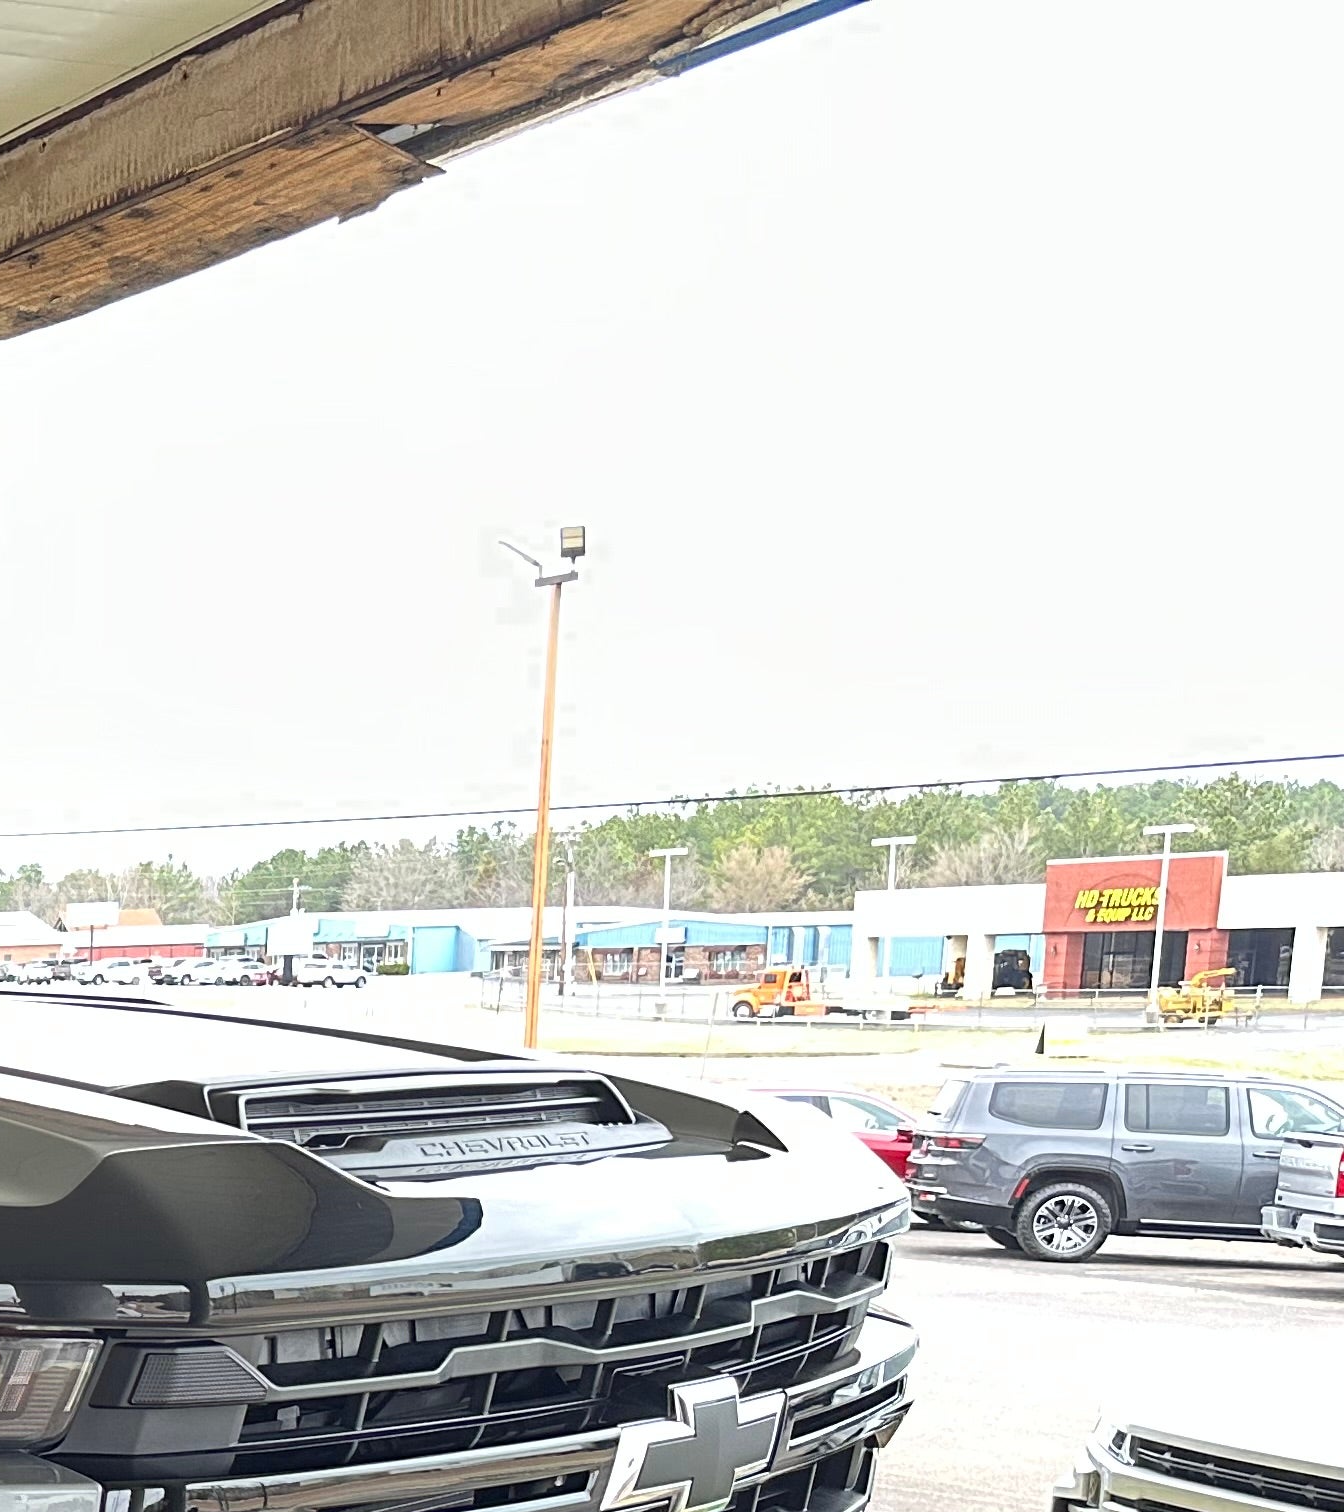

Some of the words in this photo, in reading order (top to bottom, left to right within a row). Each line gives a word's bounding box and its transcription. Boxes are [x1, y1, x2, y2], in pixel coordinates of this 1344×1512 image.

[1096, 907, 1131, 924] EQUIP
[1131, 906, 1154, 922] LLC
[416, 1131, 589, 1158] CHEVROLET
